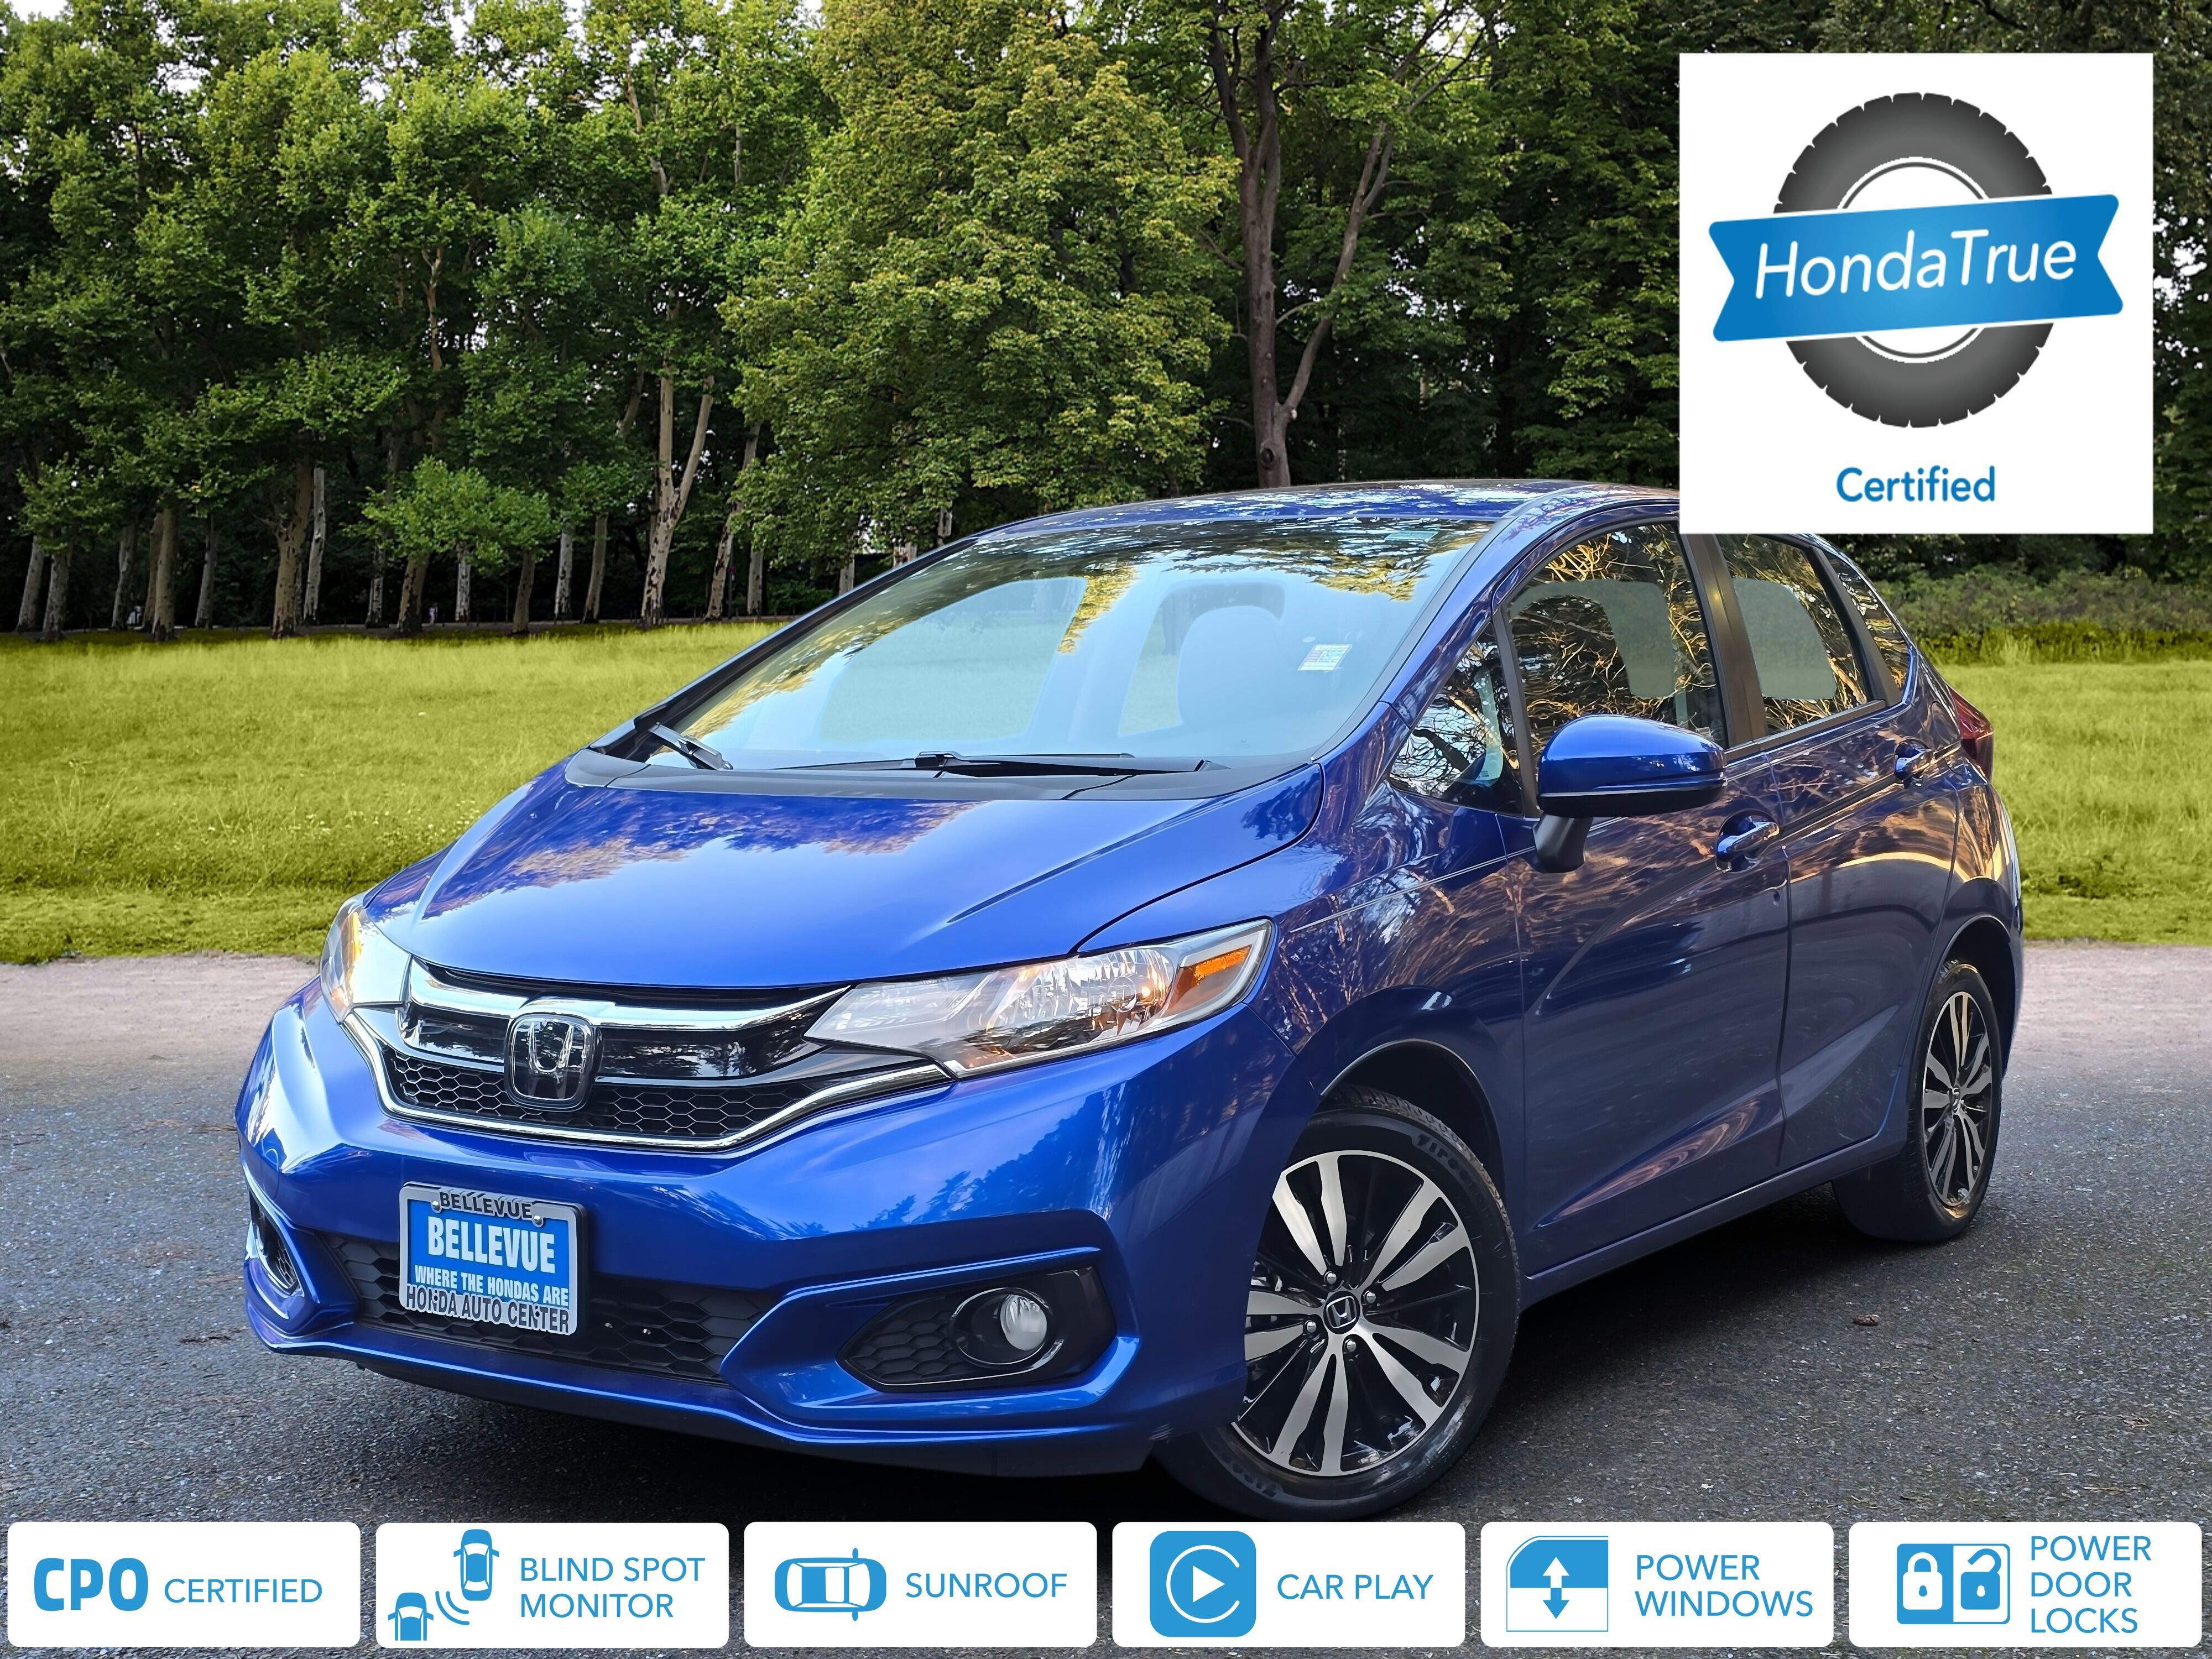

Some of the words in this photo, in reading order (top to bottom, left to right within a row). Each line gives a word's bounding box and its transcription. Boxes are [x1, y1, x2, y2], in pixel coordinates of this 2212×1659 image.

[440, 1192, 533, 1218] BELLEVUE
[428, 1216, 555, 1274] BELLEVUE
[415, 1264, 457, 1289] WHERE
[460, 1272, 483, 1293] THE
[487, 1276, 539, 1302] HONDAS
[542, 1285, 568, 1307] ARE
[406, 1285, 457, 1316] HONDA
[461, 1295, 502, 1322] AUTO
[508, 1301, 569, 1333] CENTER
